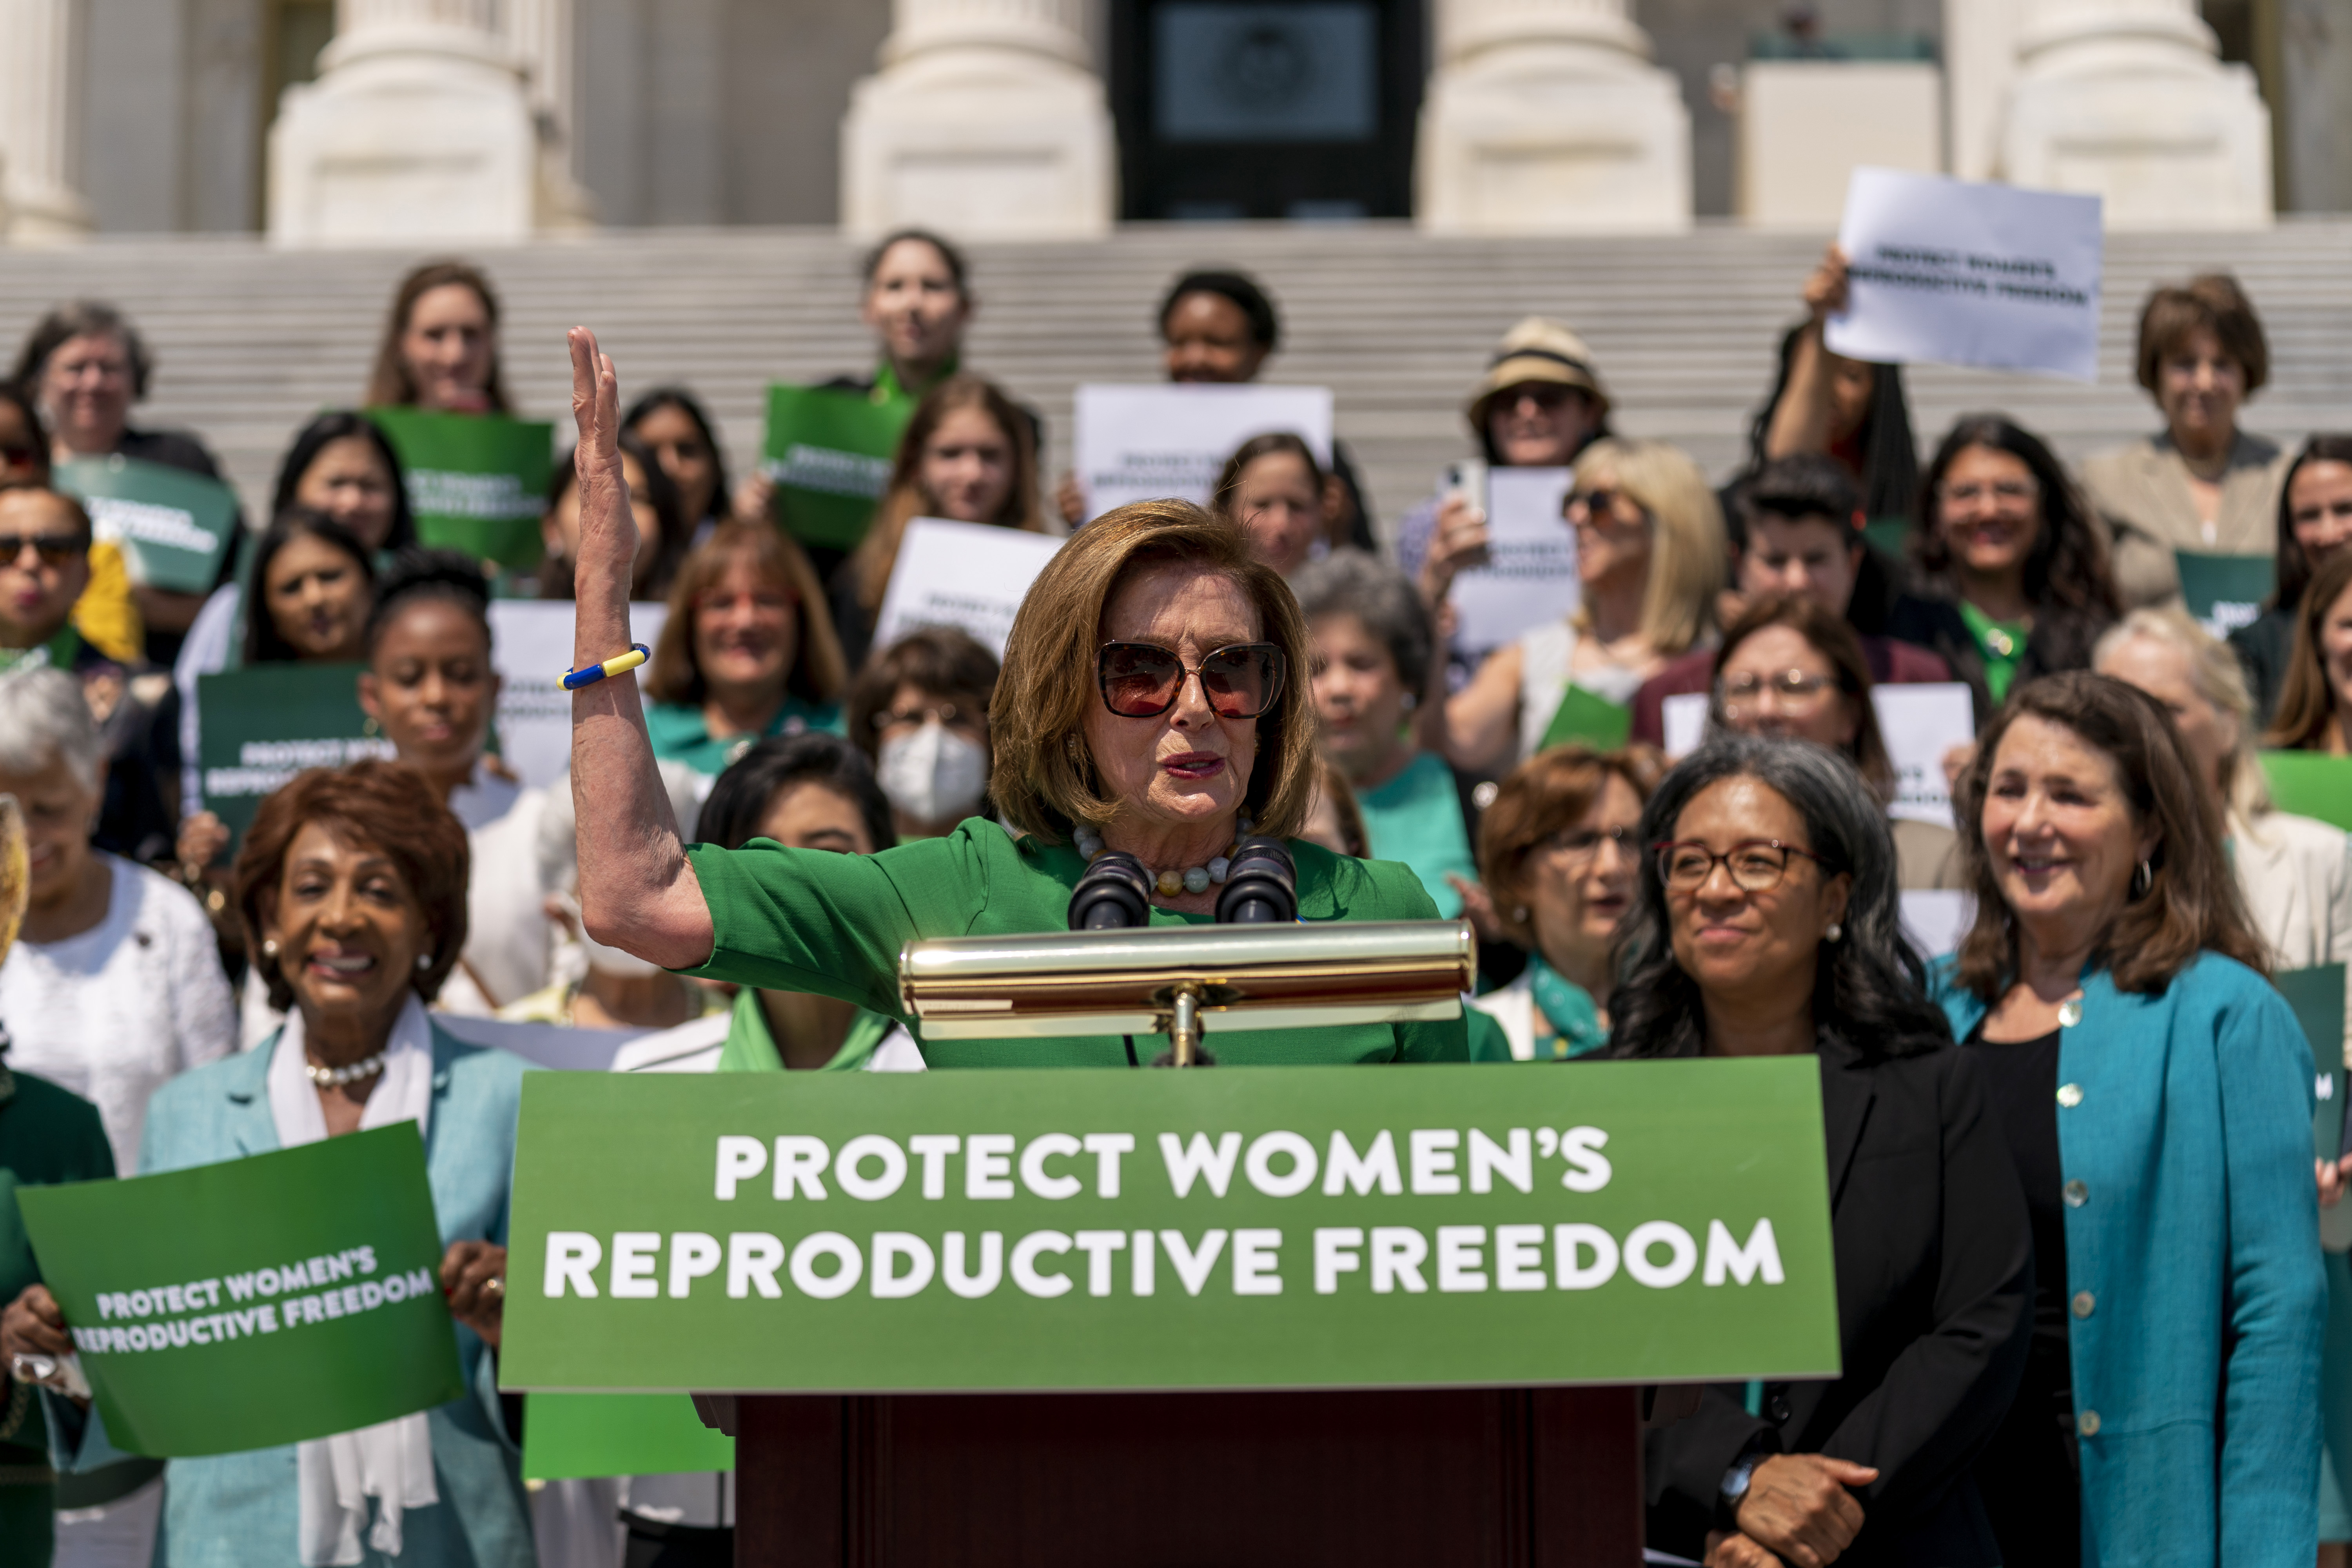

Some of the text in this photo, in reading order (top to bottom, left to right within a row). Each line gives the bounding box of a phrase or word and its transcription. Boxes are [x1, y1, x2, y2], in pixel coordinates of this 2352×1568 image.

[713, 1125, 1612, 1201] PROTECT WOMEN'S
[95, 1245, 377, 1320] PROTECT WOMEN'S
[543, 1217, 1785, 1299] REPRODUCTIVE FREEDOM
[71, 1266, 434, 1354] REPRODUCTIVE FREEDOM
